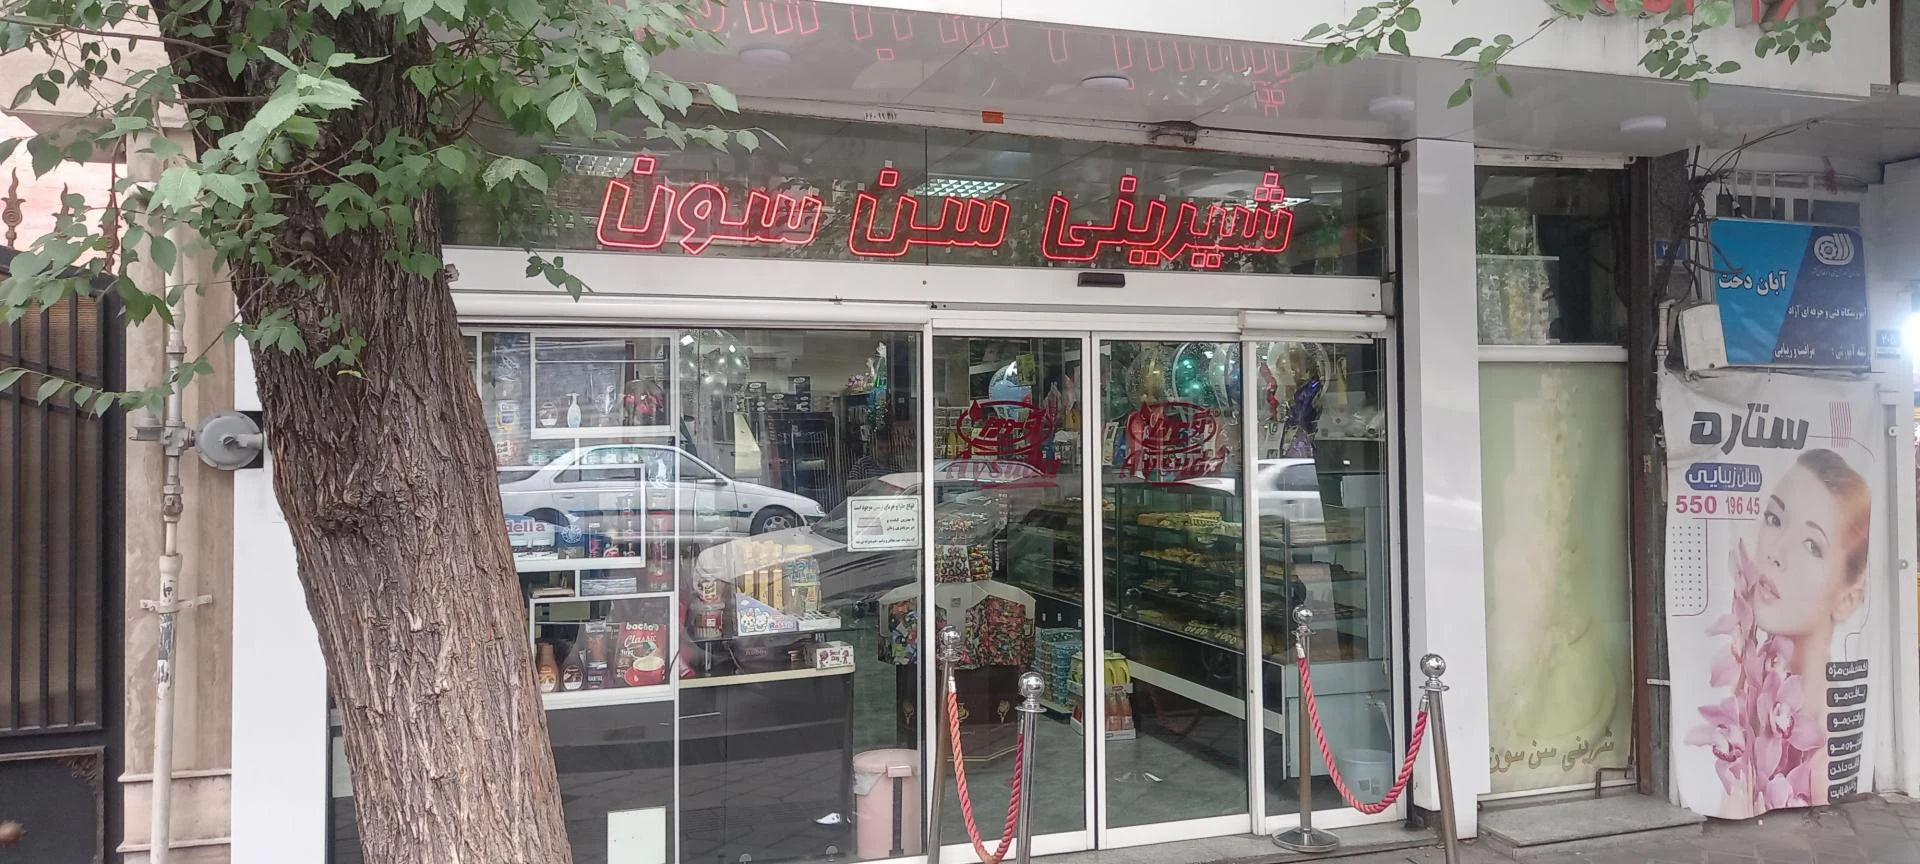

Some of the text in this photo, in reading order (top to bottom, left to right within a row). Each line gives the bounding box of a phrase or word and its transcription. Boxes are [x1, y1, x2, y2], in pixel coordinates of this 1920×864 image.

[596, 155, 1293, 269] شیرینی سن سون
[1718, 272, 1753, 290] دخت
[1757, 270, 1789, 296] آبان
[1690, 402, 1810, 455] ستاره
[1688, 465, 1761, 488] سالن زیبایی
[1676, 495, 1760, 515] 550 196 45
[1828, 663, 1843, 678] مژه
[1833, 692, 1848, 703] مو
[1833, 717, 1847, 728] مو
[1528, 739, 1557, 770] سن
[1830, 743, 1845, 754] مو
[1489, 746, 1525, 774] سون
